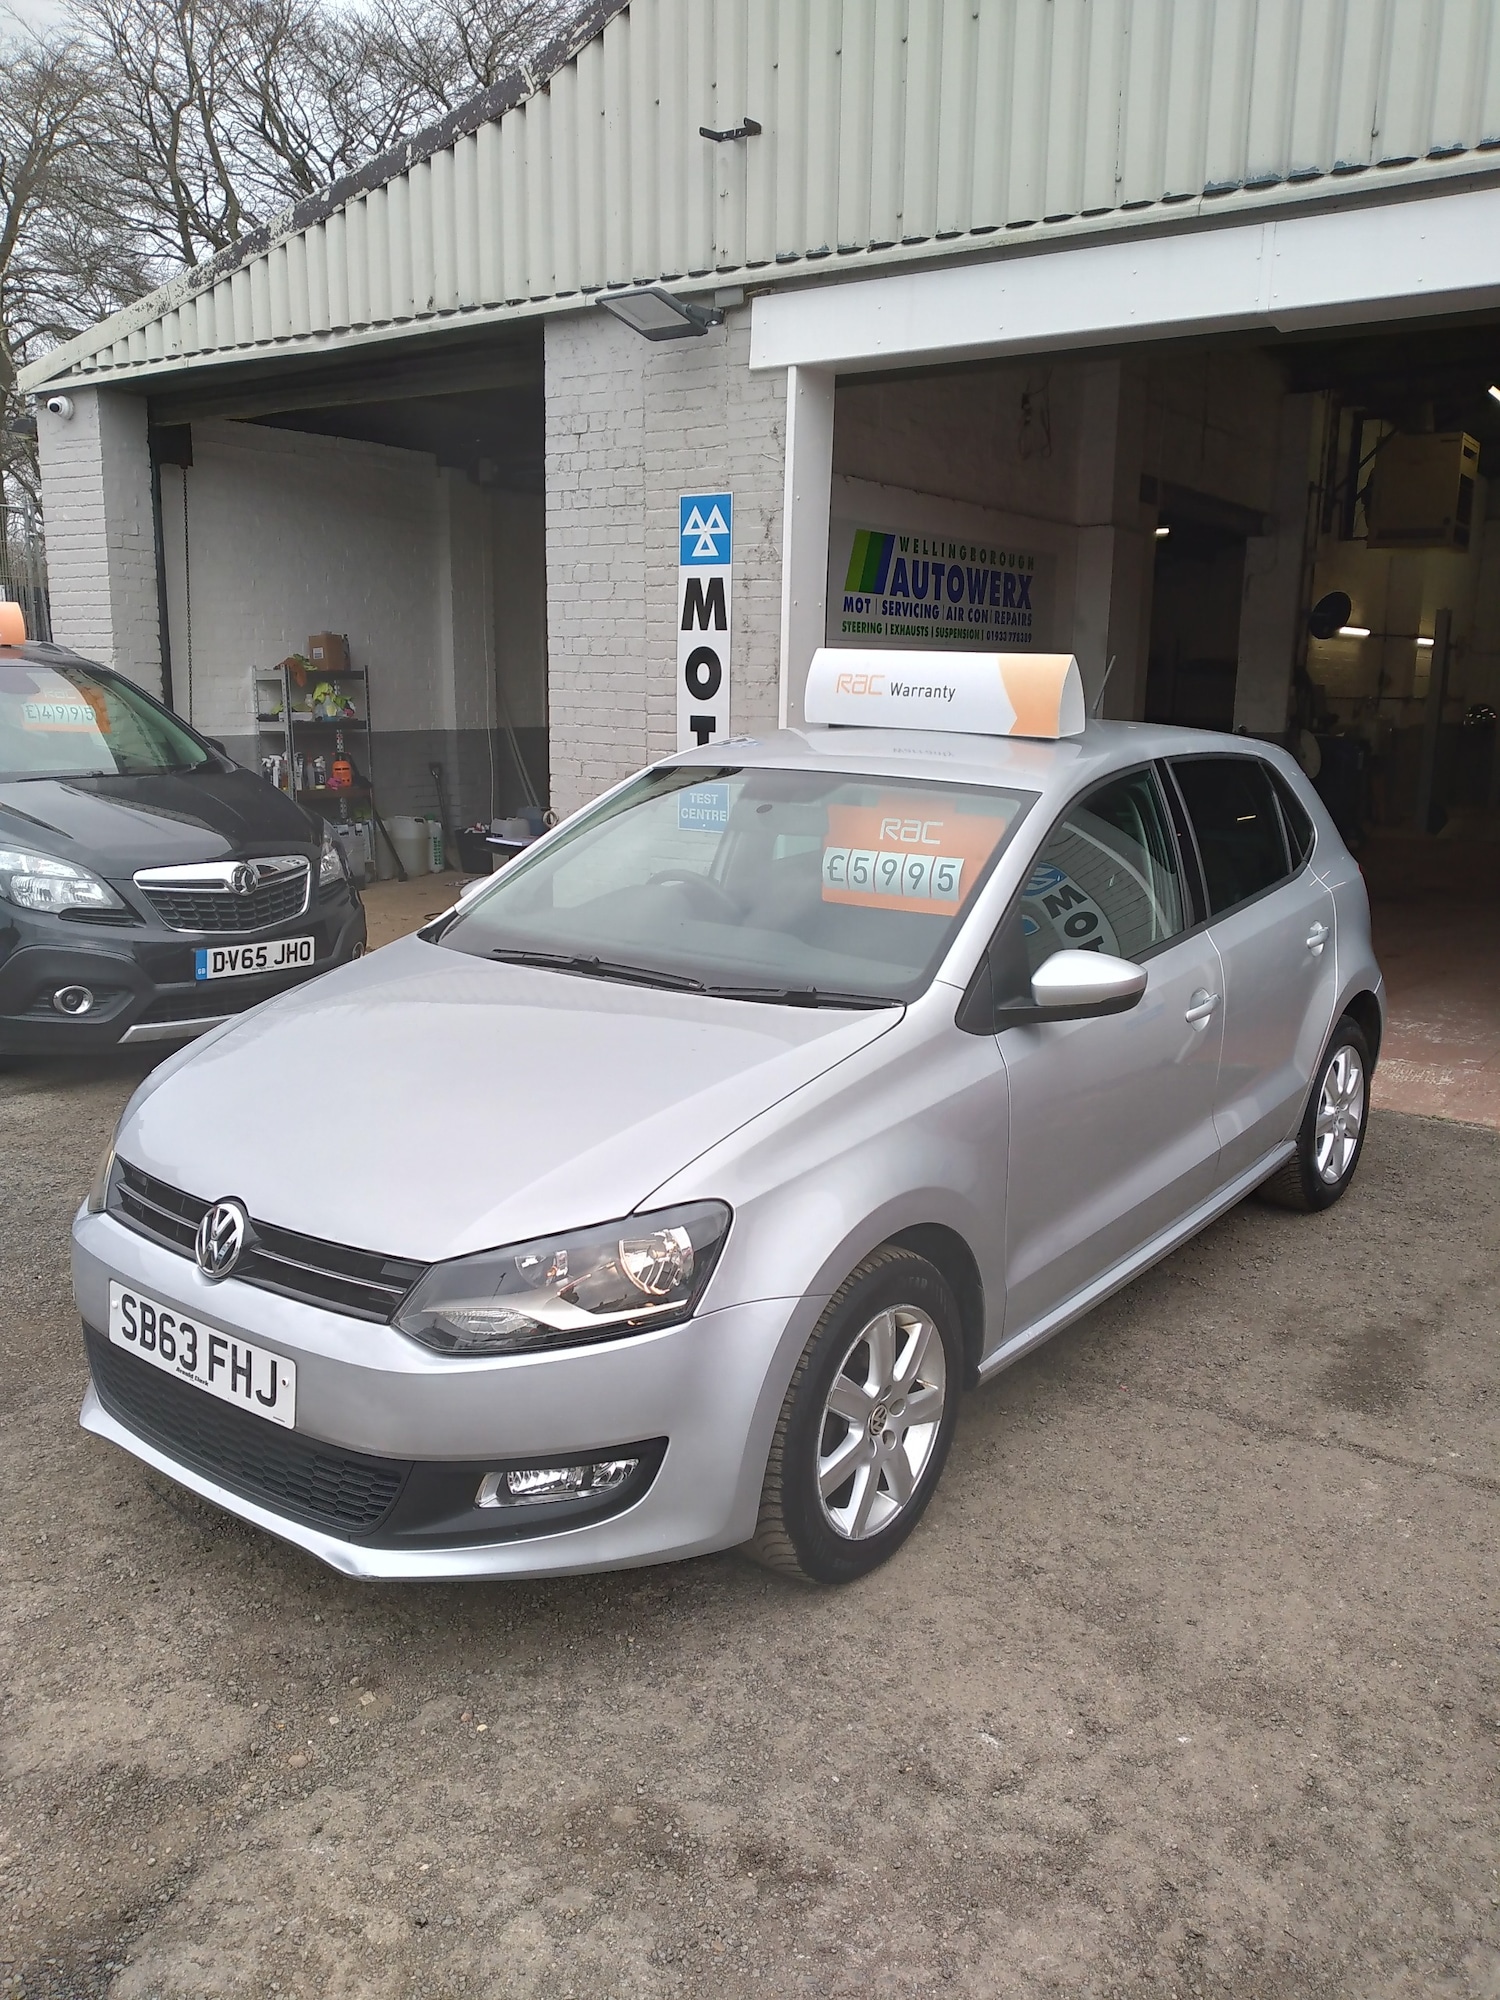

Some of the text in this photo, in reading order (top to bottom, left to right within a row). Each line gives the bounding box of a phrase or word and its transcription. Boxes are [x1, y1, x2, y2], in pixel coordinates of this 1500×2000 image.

[899, 536, 1034, 570] WELLINGBOROUGH
[890, 557, 1033, 610] AUTOWERX
[843, 596, 1032, 627] MOT SERVICING AIR CON REPAIRS
[841, 620, 883, 635] STEERING
[890, 623, 929, 638] EXHAUSTS
[935, 627, 980, 641] SUSPENSION
[681, 577, 728, 747] MOT
[890, 682, 956, 702] Warranty
[25, 704, 95, 721] £4995
[689, 792, 719, 805] TEST
[681, 808, 727, 822] CENTRE
[826, 854, 957, 892] £5995
[197, 967, 206, 975] GB
[213, 941, 311, 973] DV65 JHO
[121, 1293, 278, 1408] SB63 FHJ
